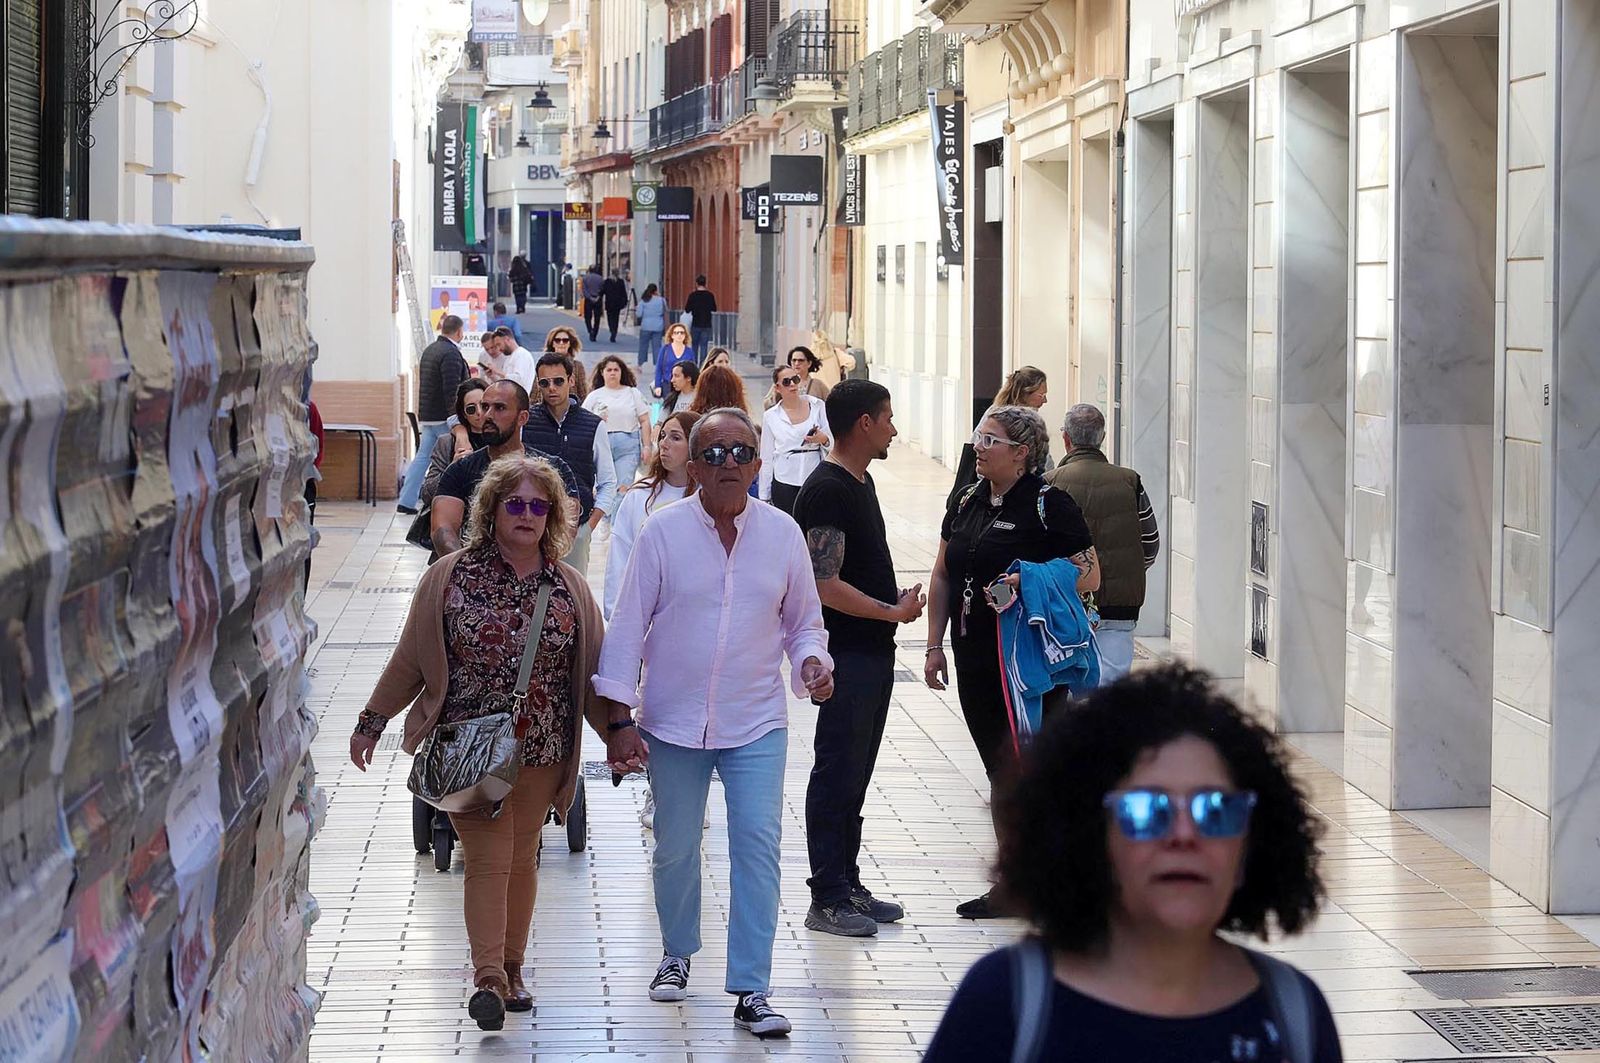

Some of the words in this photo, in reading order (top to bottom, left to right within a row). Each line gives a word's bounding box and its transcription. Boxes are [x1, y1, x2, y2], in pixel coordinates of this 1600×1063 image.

[943, 104, 955, 155] VIAJES
[444, 129, 457, 165] LOLA
[444, 166, 455, 178] Y
[528, 165, 560, 180] BBV
[846, 154, 856, 170] EST
[846, 171, 856, 194] REAL
[443, 180, 455, 225] BIMBA
[773, 191, 818, 202] TEZENIS
[846, 195, 856, 223] LYNCIS
